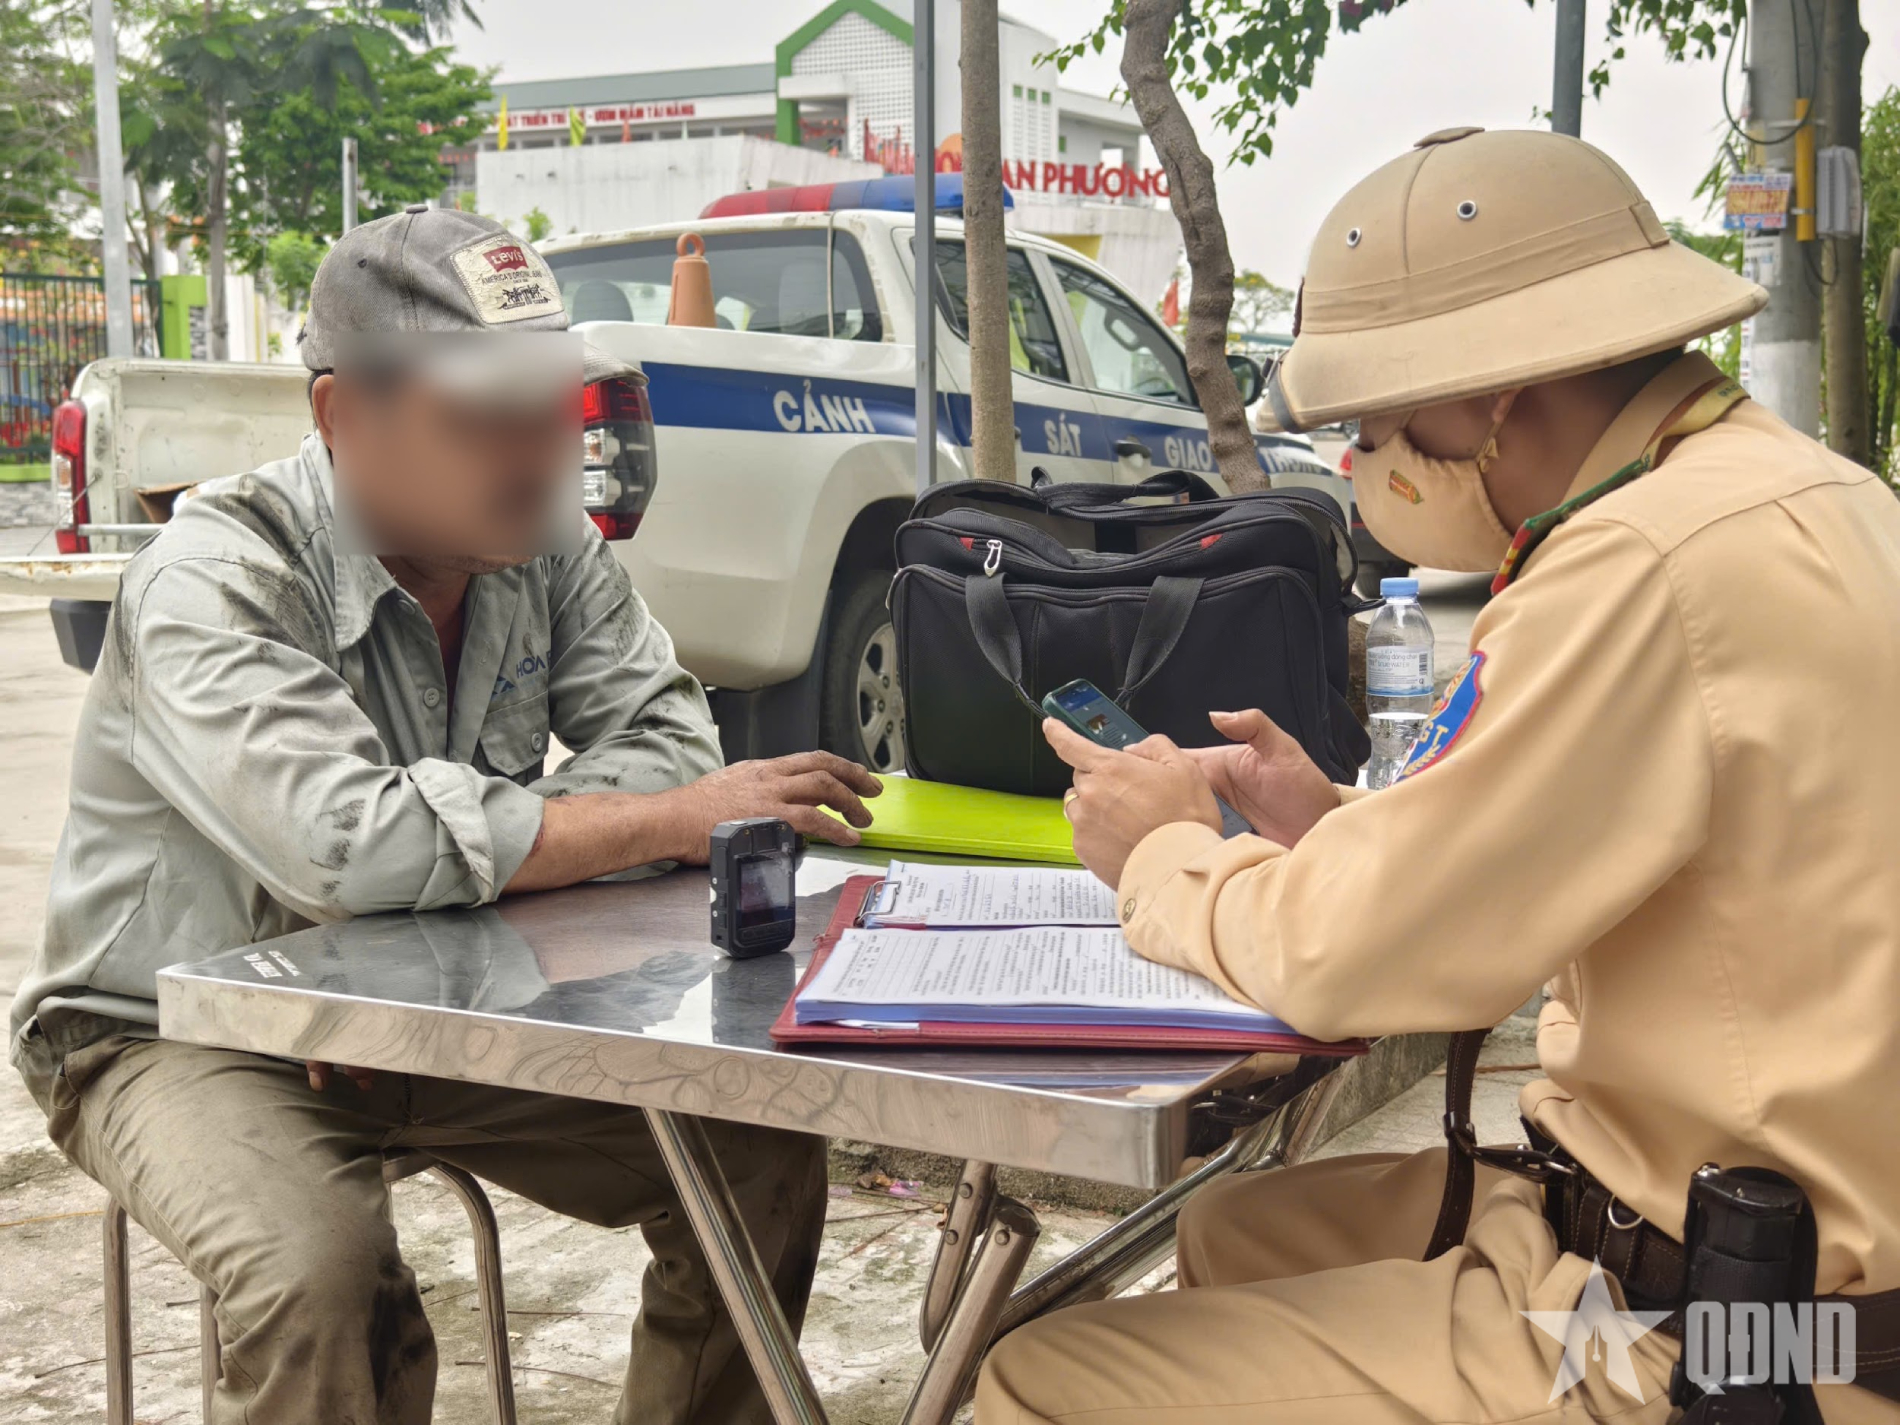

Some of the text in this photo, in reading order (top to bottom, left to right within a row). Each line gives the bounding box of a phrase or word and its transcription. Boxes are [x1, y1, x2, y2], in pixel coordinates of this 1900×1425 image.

[773, 379, 877, 433] CẢNH
[1044, 412, 1082, 457] SÁT
[1164, 436, 1214, 471] GIAO
